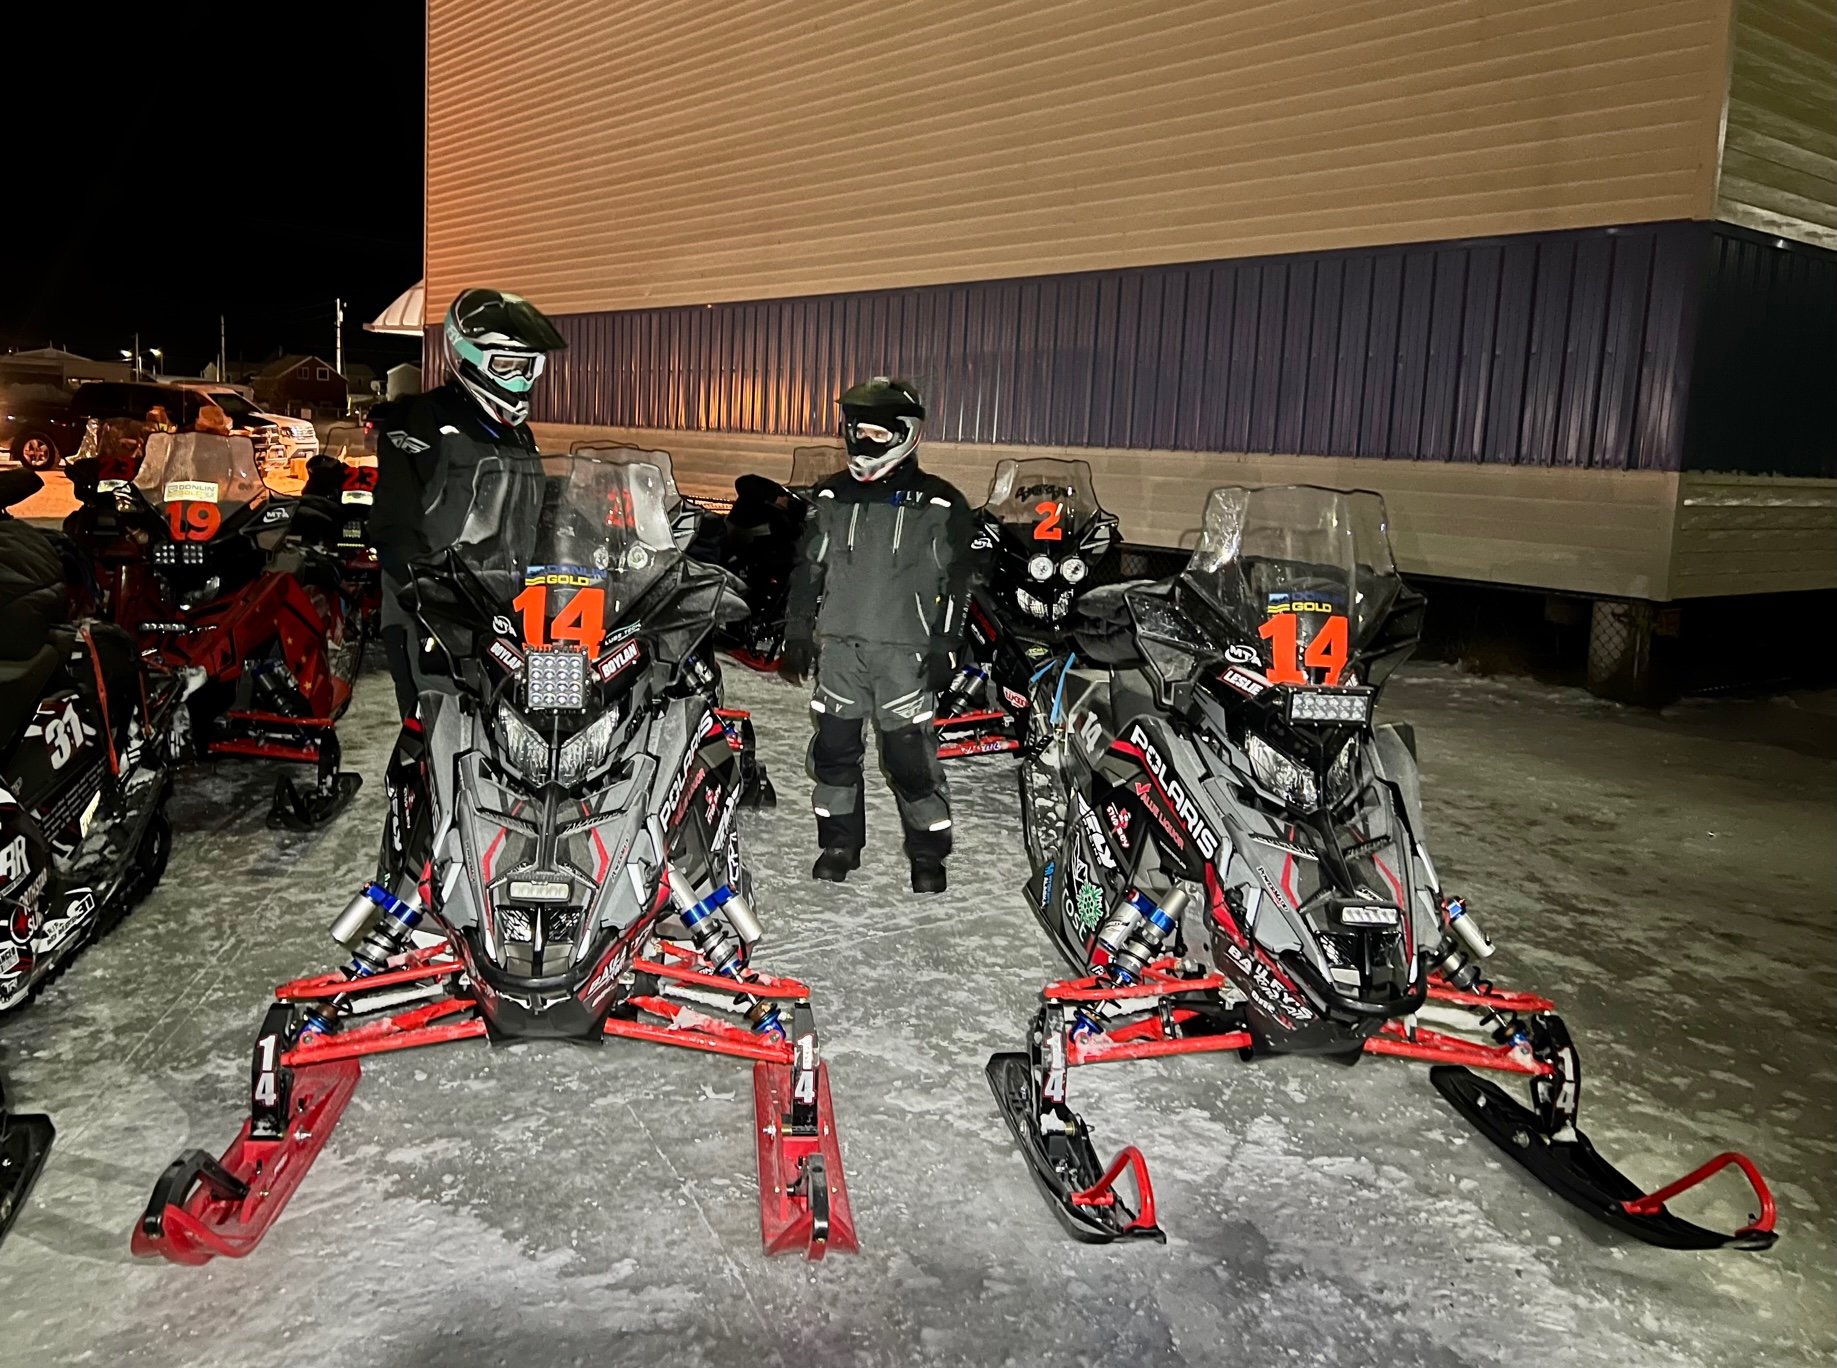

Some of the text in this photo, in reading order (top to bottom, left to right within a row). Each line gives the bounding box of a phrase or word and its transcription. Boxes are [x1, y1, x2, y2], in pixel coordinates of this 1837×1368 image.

[342, 466, 378, 491] 23
[165, 500, 221, 541] 19
[263, 508, 290, 522] MTA
[1033, 501, 1062, 541] 2
[546, 574, 590, 587] GOLD
[1291, 602, 1332, 613] GOLD
[512, 585, 607, 661] 14
[1257, 612, 1349, 686] 14
[601, 645, 638, 679] BOYLAN
[1223, 670, 1264, 696] LESLIE
[1224, 644, 1263, 668] MTA
[44, 702, 84, 771] 31
[659, 709, 713, 833] POLARIS
[1130, 724, 1218, 860] POLARIS
[254, 1034, 277, 1106] 14
[794, 1034, 815, 1104] 14
[1044, 1030, 1065, 1102] 14
[1556, 1046, 1576, 1114] 14
